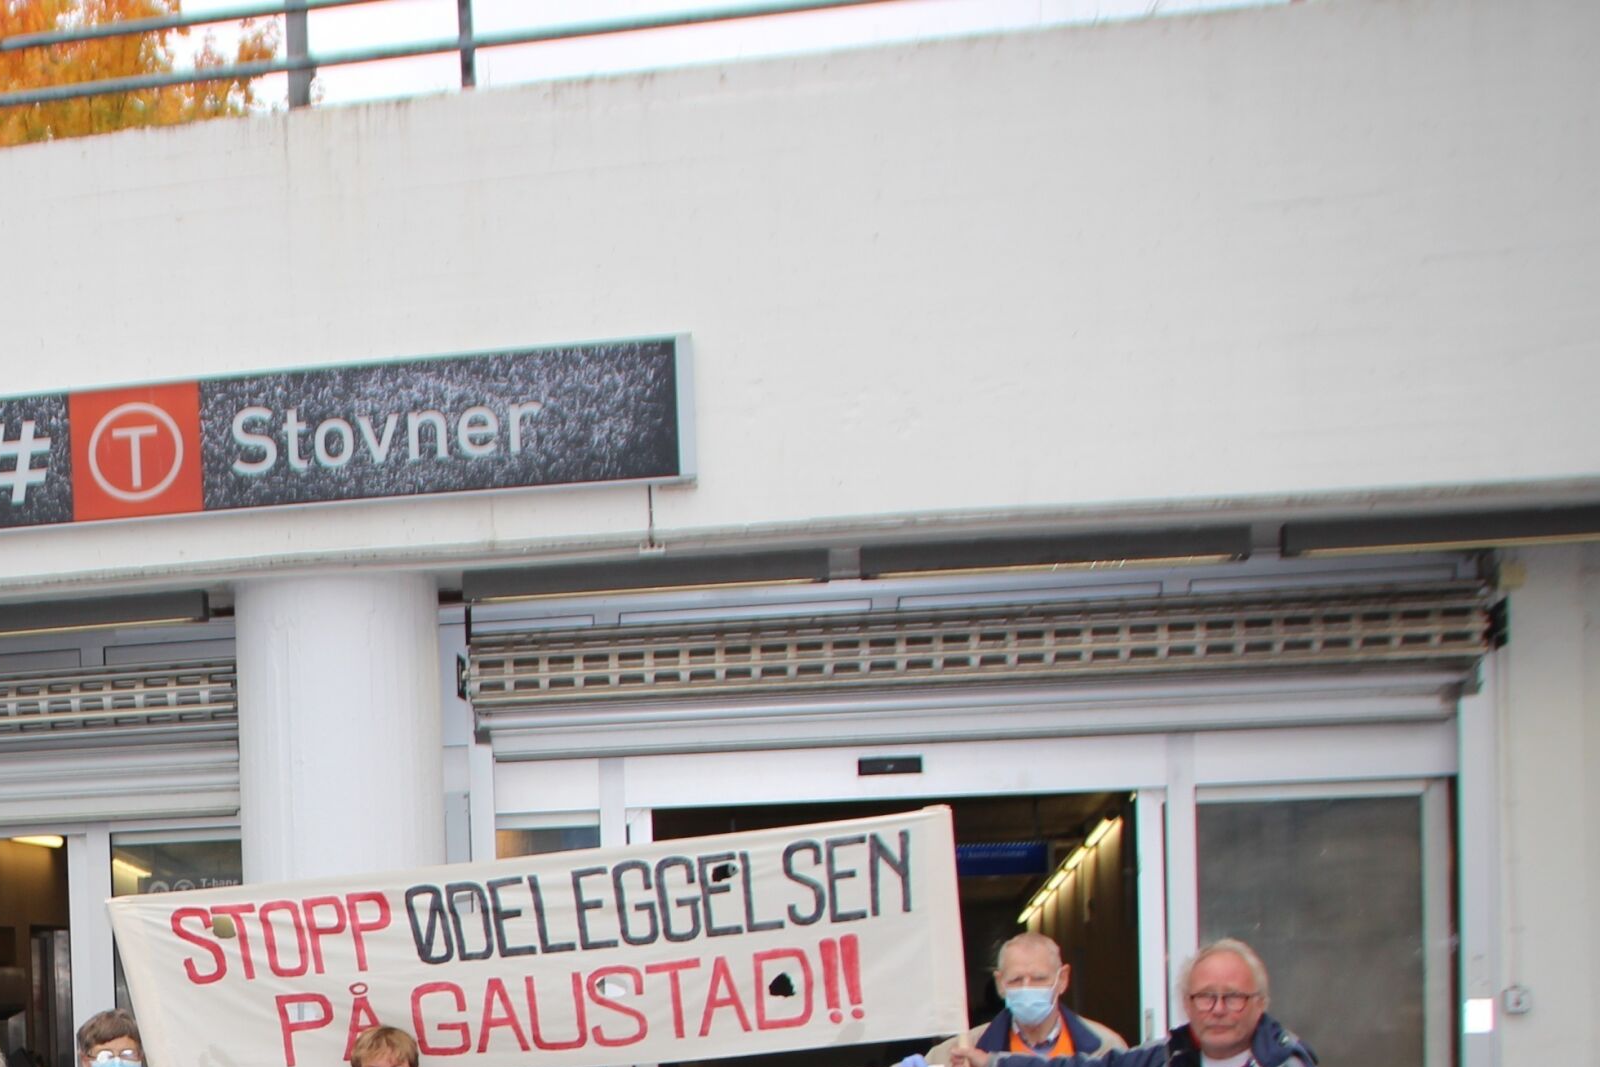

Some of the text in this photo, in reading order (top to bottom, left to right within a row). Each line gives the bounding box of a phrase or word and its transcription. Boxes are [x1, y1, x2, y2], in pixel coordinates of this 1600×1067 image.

[112, 425, 158, 489] T
[231, 401, 541, 477] Stovner
[170, 830, 913, 985] STOPP ØDELEGGELSEN
[276, 933, 866, 1067] PÅ GAUSTAD!!
